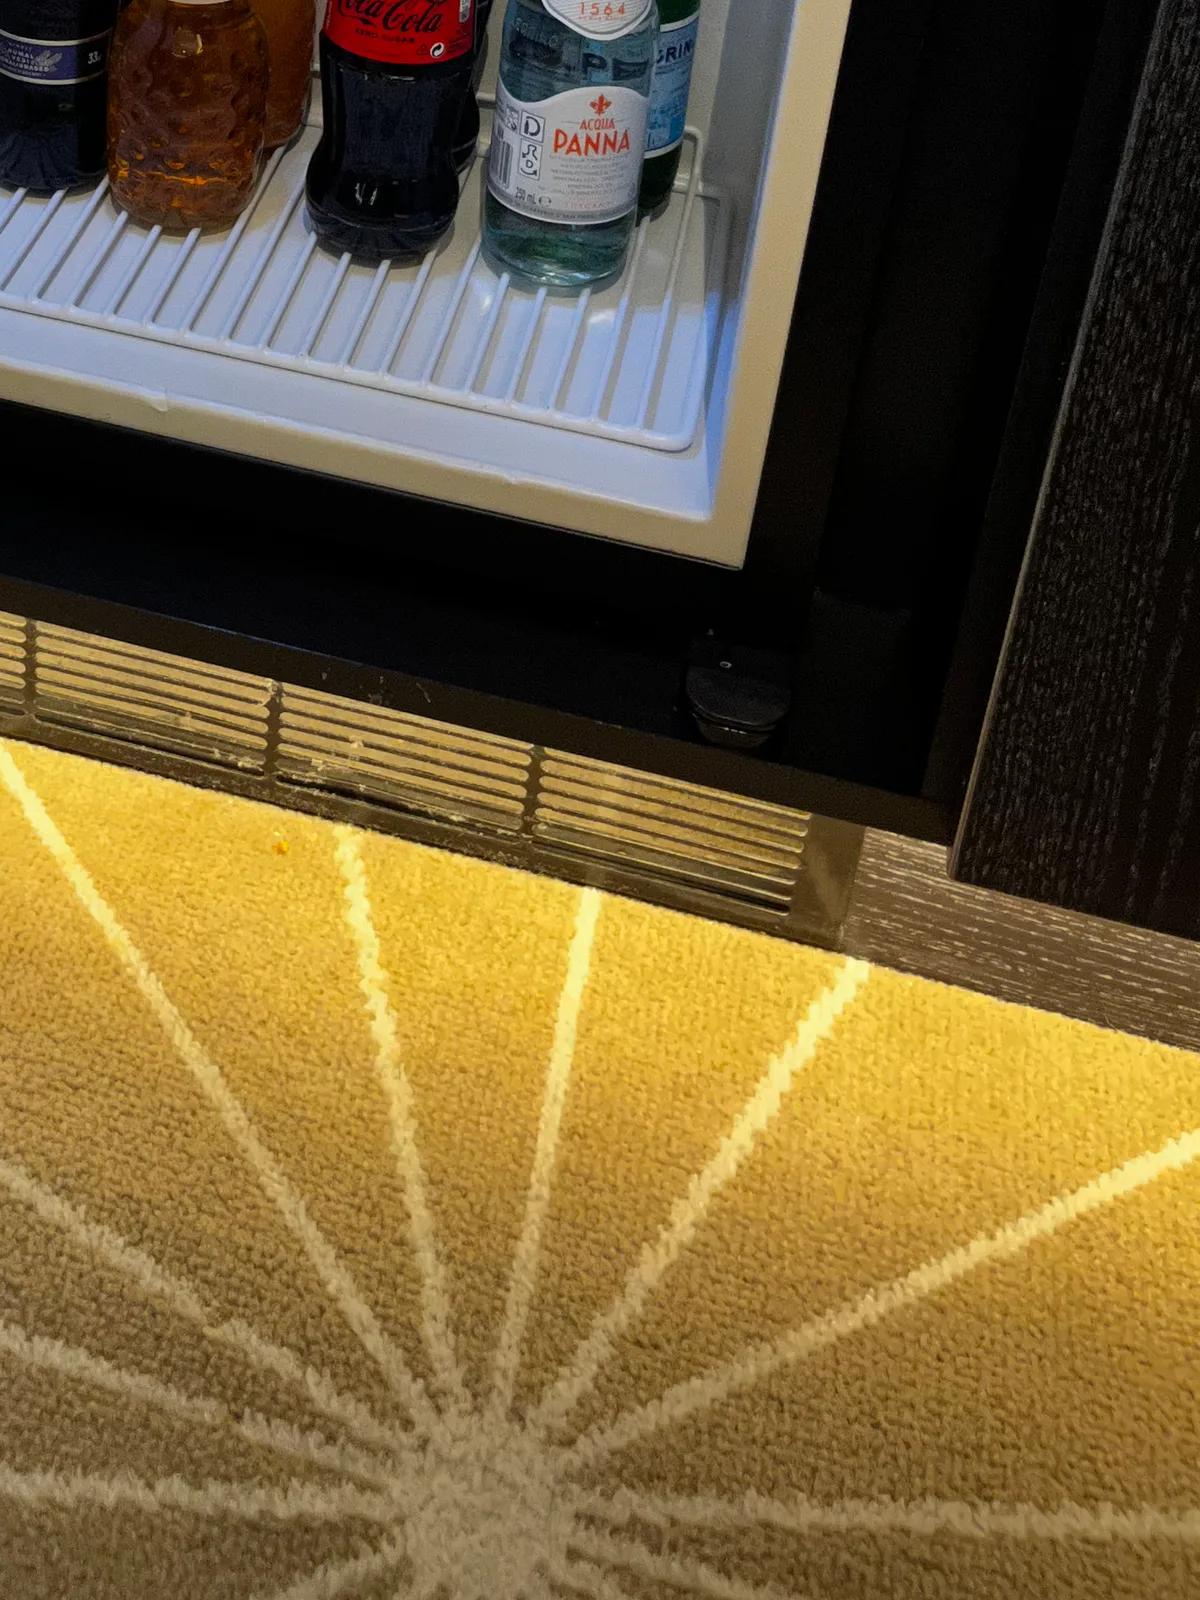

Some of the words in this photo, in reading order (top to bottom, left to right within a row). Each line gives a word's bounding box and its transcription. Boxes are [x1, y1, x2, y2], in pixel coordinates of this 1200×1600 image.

[580, 2, 625, 16] 1564
[579, 118, 615, 131] ACQUA
[553, 128, 630, 156] PANNA
